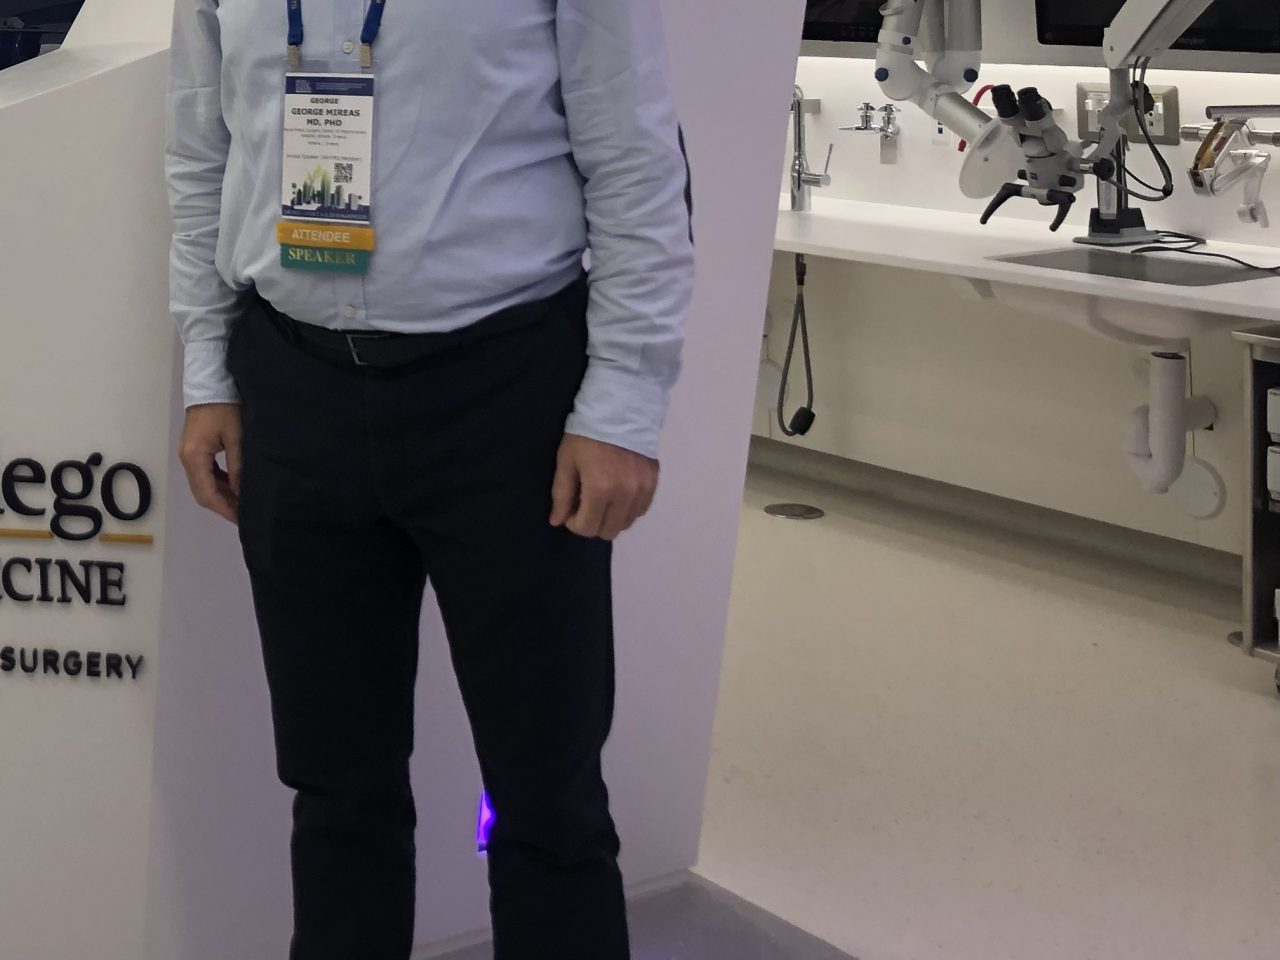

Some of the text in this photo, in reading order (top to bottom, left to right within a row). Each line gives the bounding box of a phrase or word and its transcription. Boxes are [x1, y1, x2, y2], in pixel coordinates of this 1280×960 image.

[309, 97, 339, 105] GEORGE
[291, 107, 361, 117] GEORGE MIREAS
[324, 118, 342, 127] PHD
[291, 228, 350, 243] ATTENDEE
[288, 247, 356, 264] SPEAKER
[0, 646, 144, 680] SURGERY
